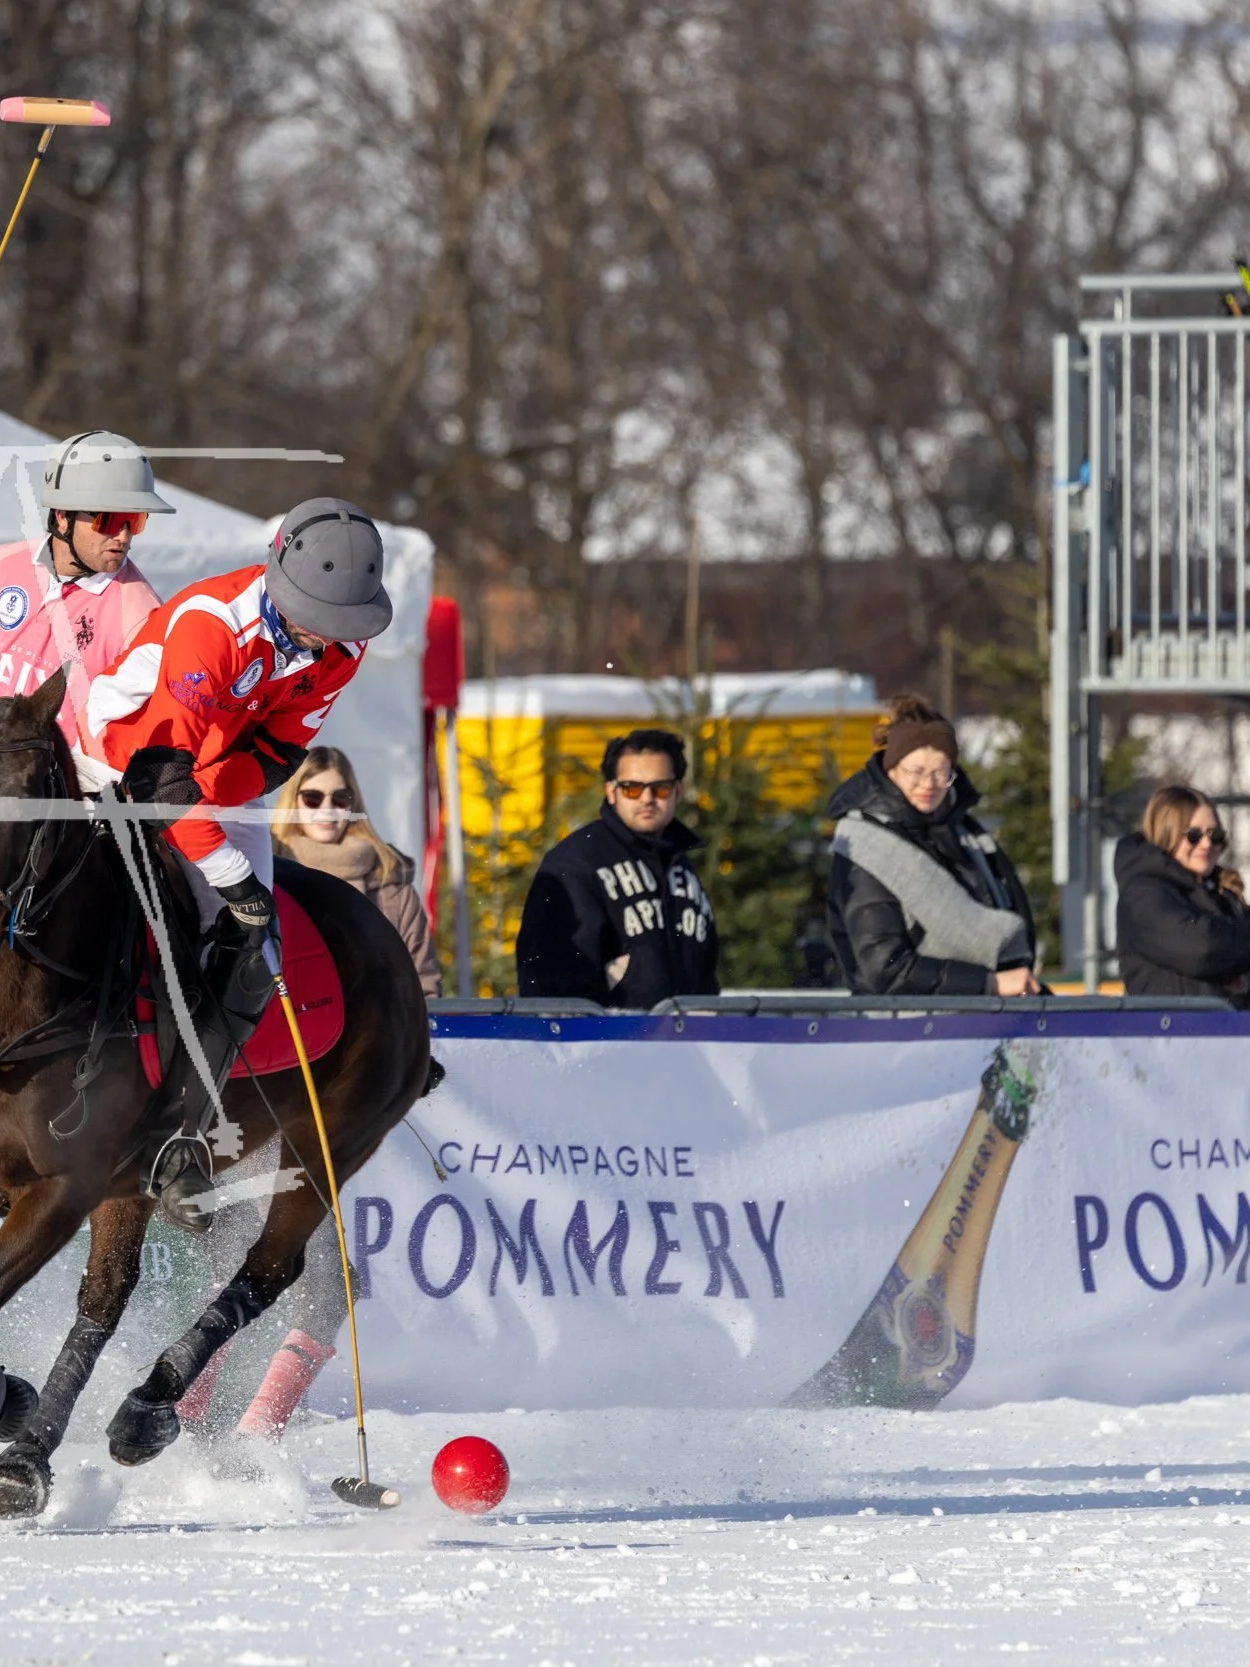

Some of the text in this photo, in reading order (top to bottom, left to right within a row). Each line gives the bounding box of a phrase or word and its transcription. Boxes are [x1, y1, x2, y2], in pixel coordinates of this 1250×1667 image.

[438, 1142, 695, 1177] CHAMPAGNE
[942, 1131, 996, 1254] POMMERY
[355, 1193, 786, 1300] POMMERY
